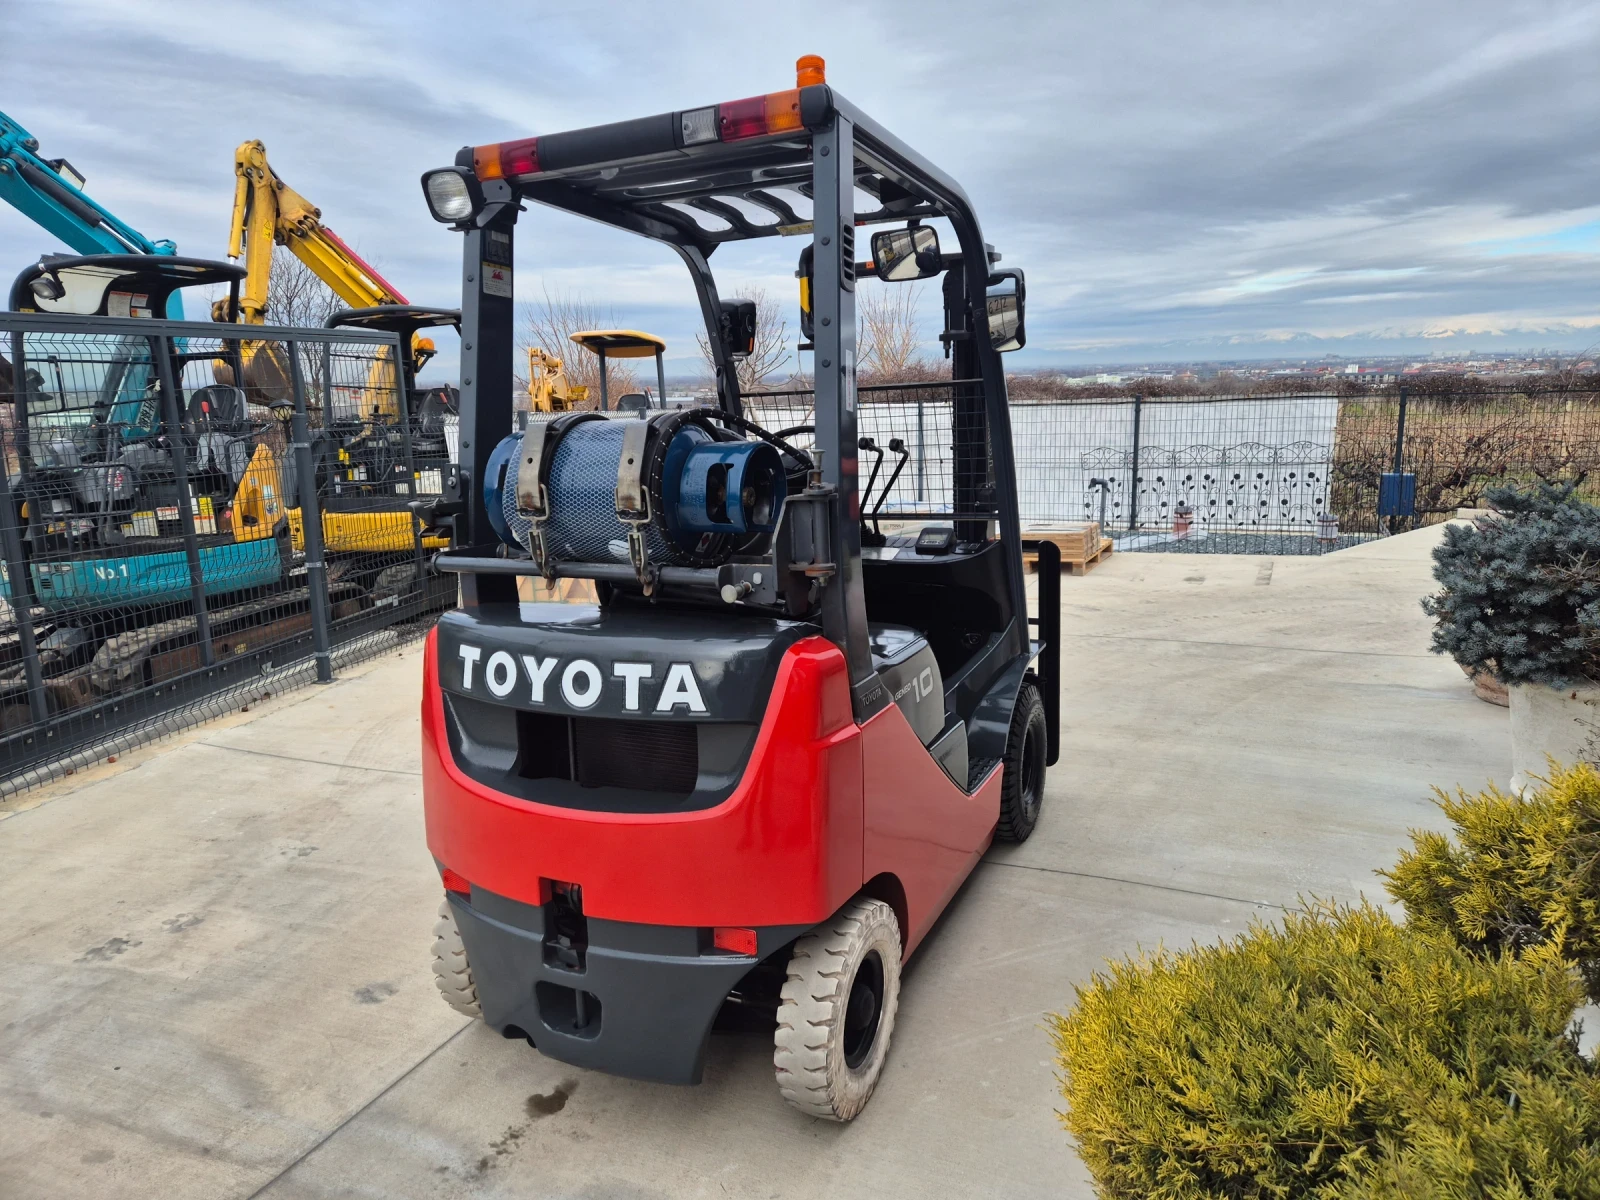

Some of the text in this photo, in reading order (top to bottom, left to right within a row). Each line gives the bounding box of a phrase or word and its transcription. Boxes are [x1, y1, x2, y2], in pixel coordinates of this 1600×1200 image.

[459, 644, 708, 713] TOYOTA
[862, 687, 882, 707] TOYOTA
[912, 666, 934, 703] 10
